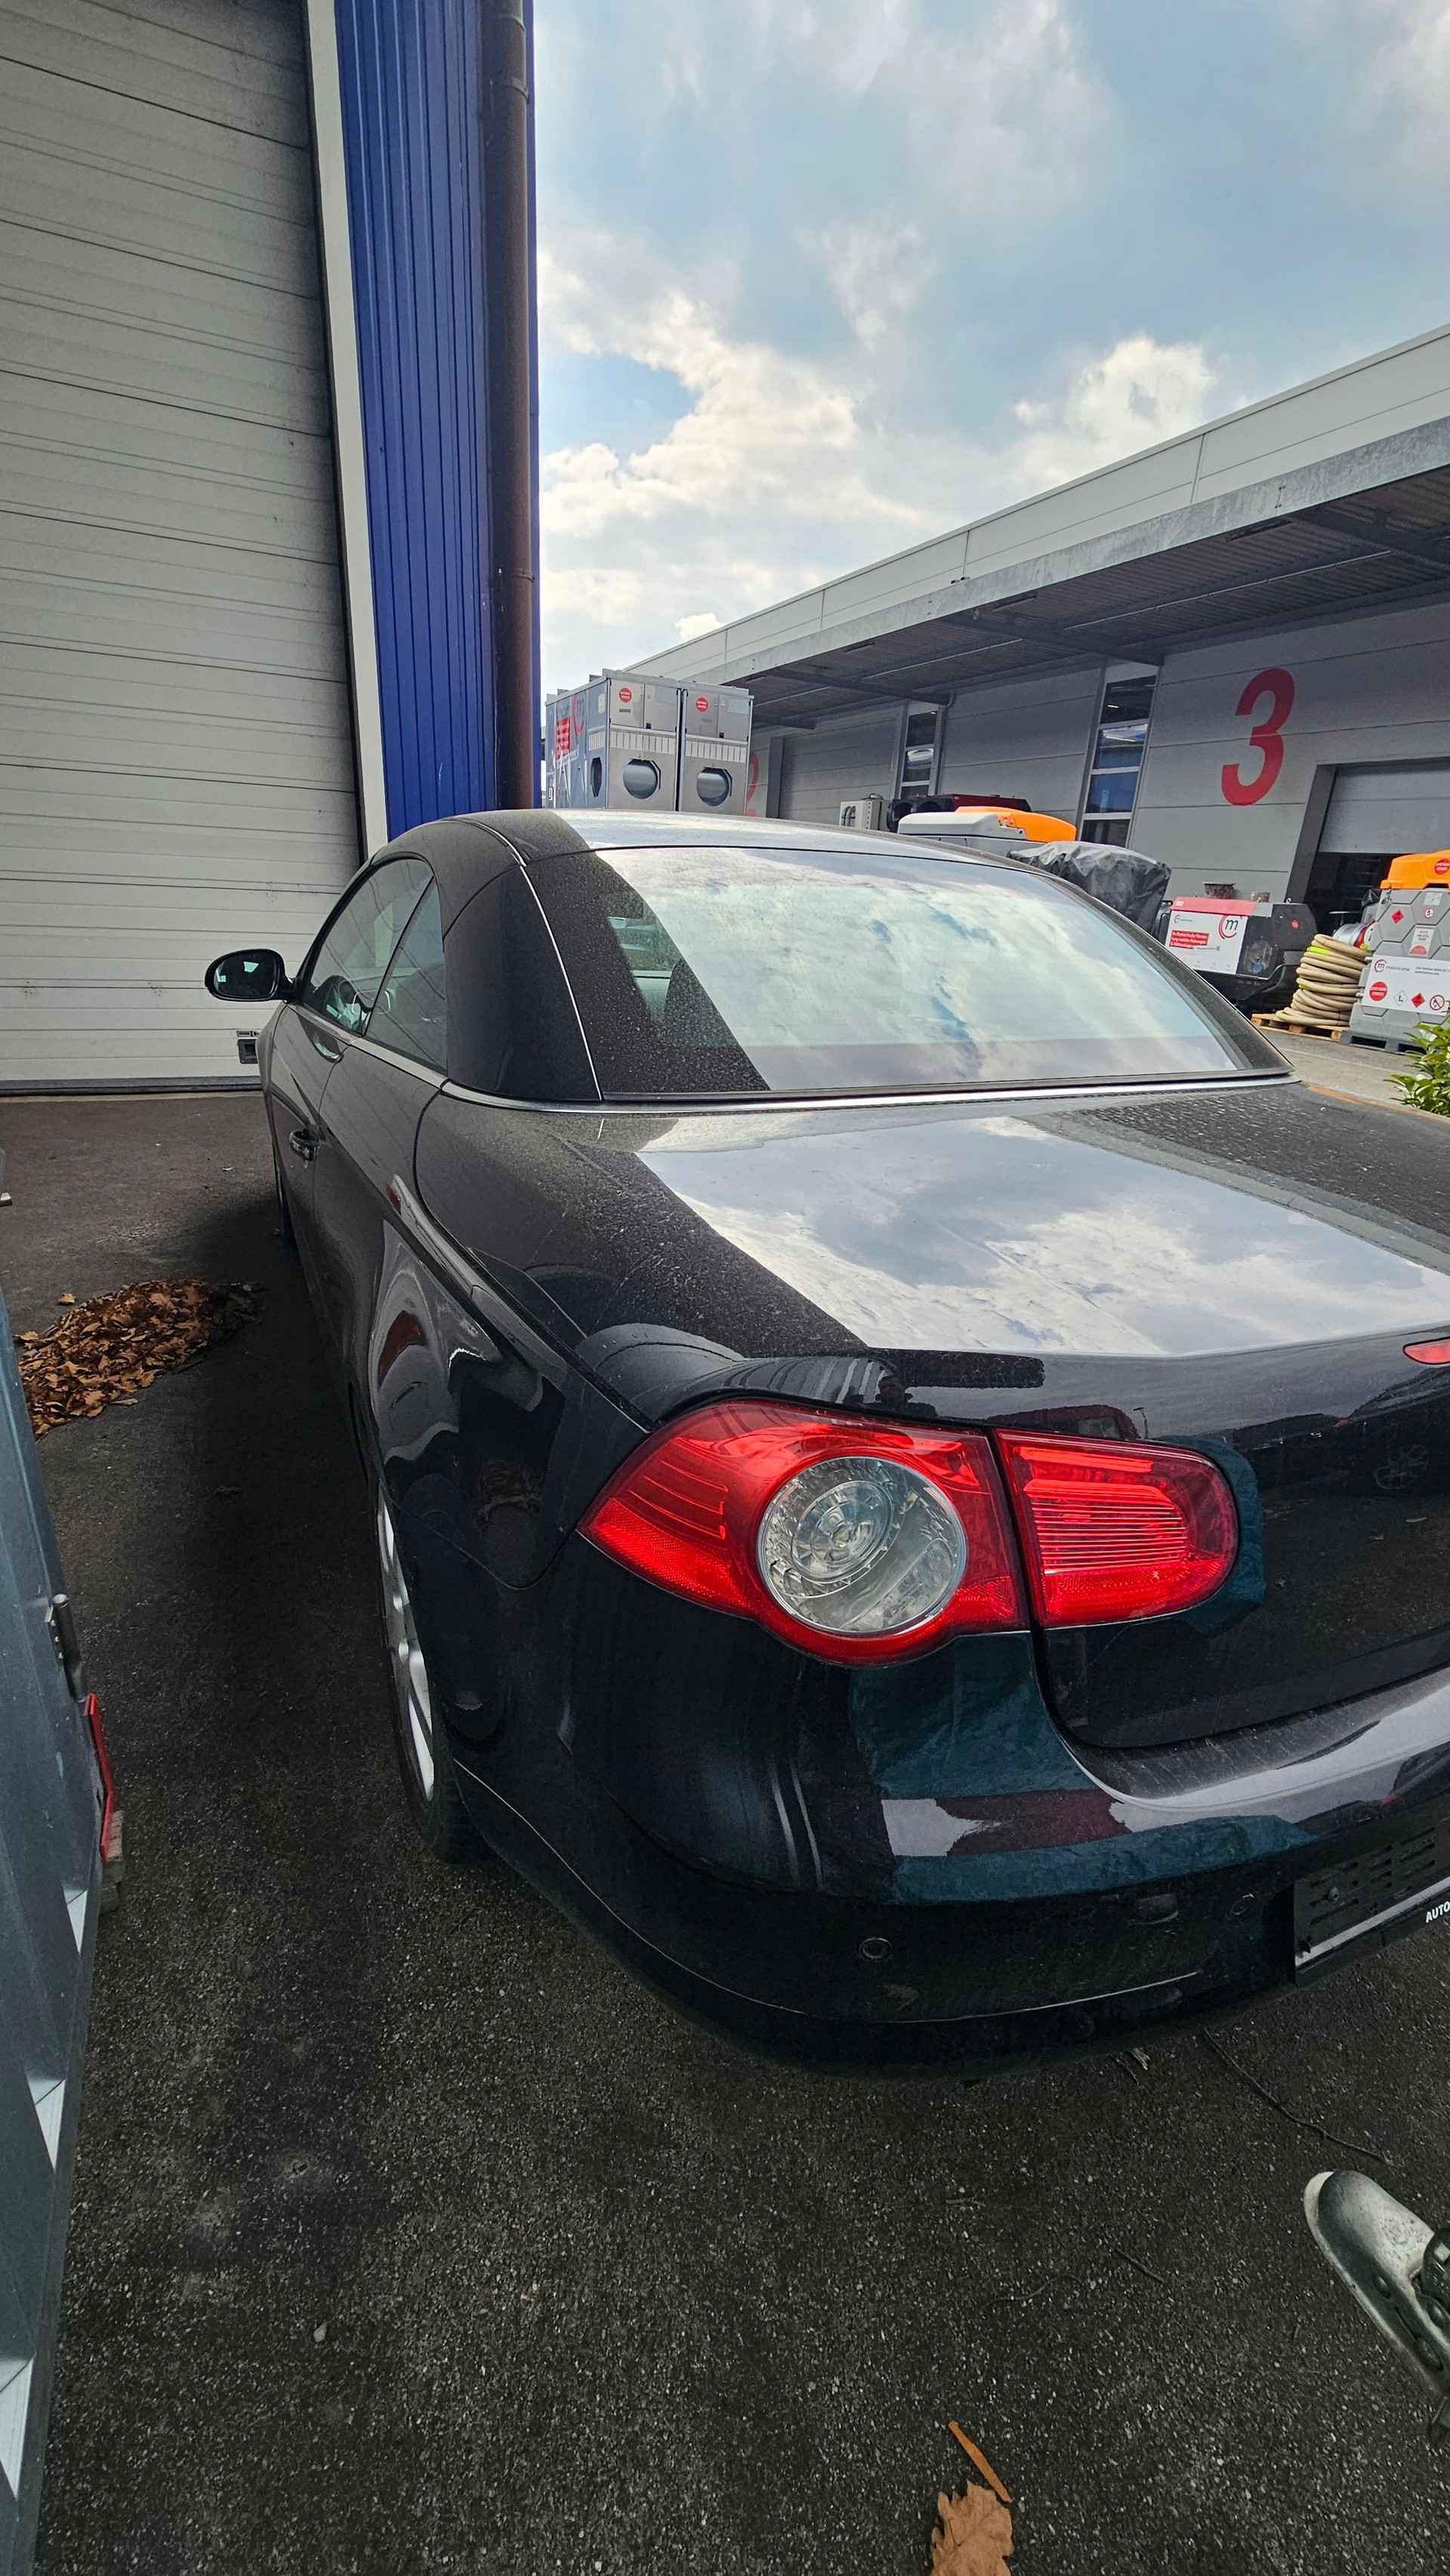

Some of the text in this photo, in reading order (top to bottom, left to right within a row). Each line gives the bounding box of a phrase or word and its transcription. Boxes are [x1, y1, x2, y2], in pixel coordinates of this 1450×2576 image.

[1221, 668, 1295, 806] 3
[1224, 919, 1239, 931] m
[1426, 1901, 1450, 1923] AUTO
